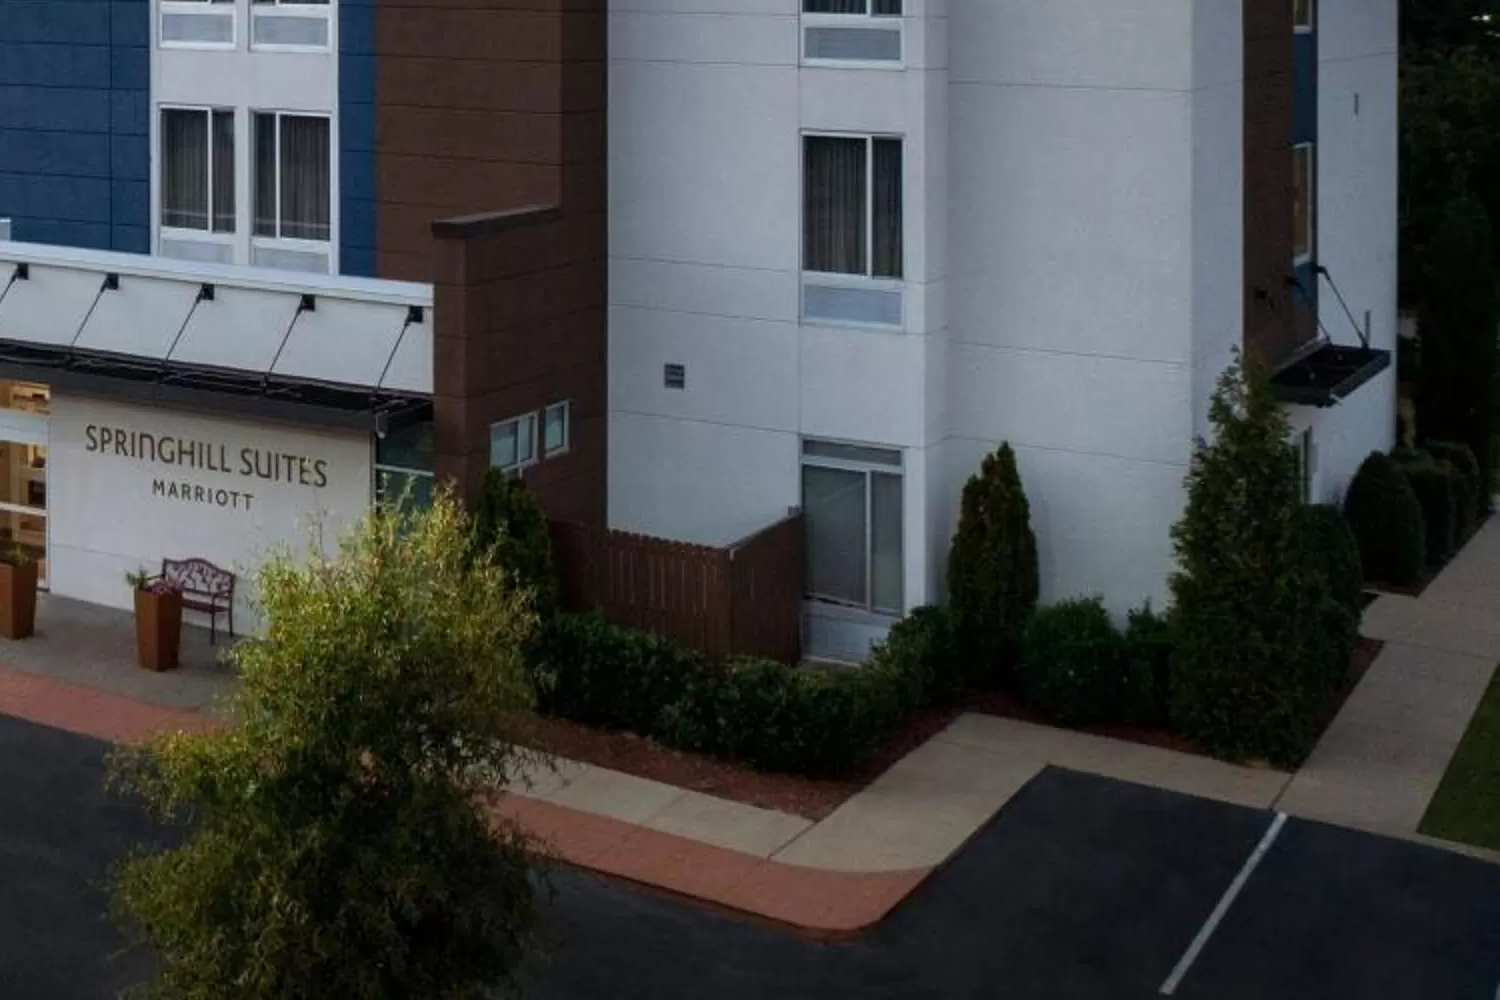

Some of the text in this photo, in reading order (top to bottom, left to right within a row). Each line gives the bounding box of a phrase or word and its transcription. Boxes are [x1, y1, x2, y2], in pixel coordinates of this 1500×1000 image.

[85, 424, 328, 488] SPRINGHILL SUITES
[152, 479, 255, 512] MARRIOTT
